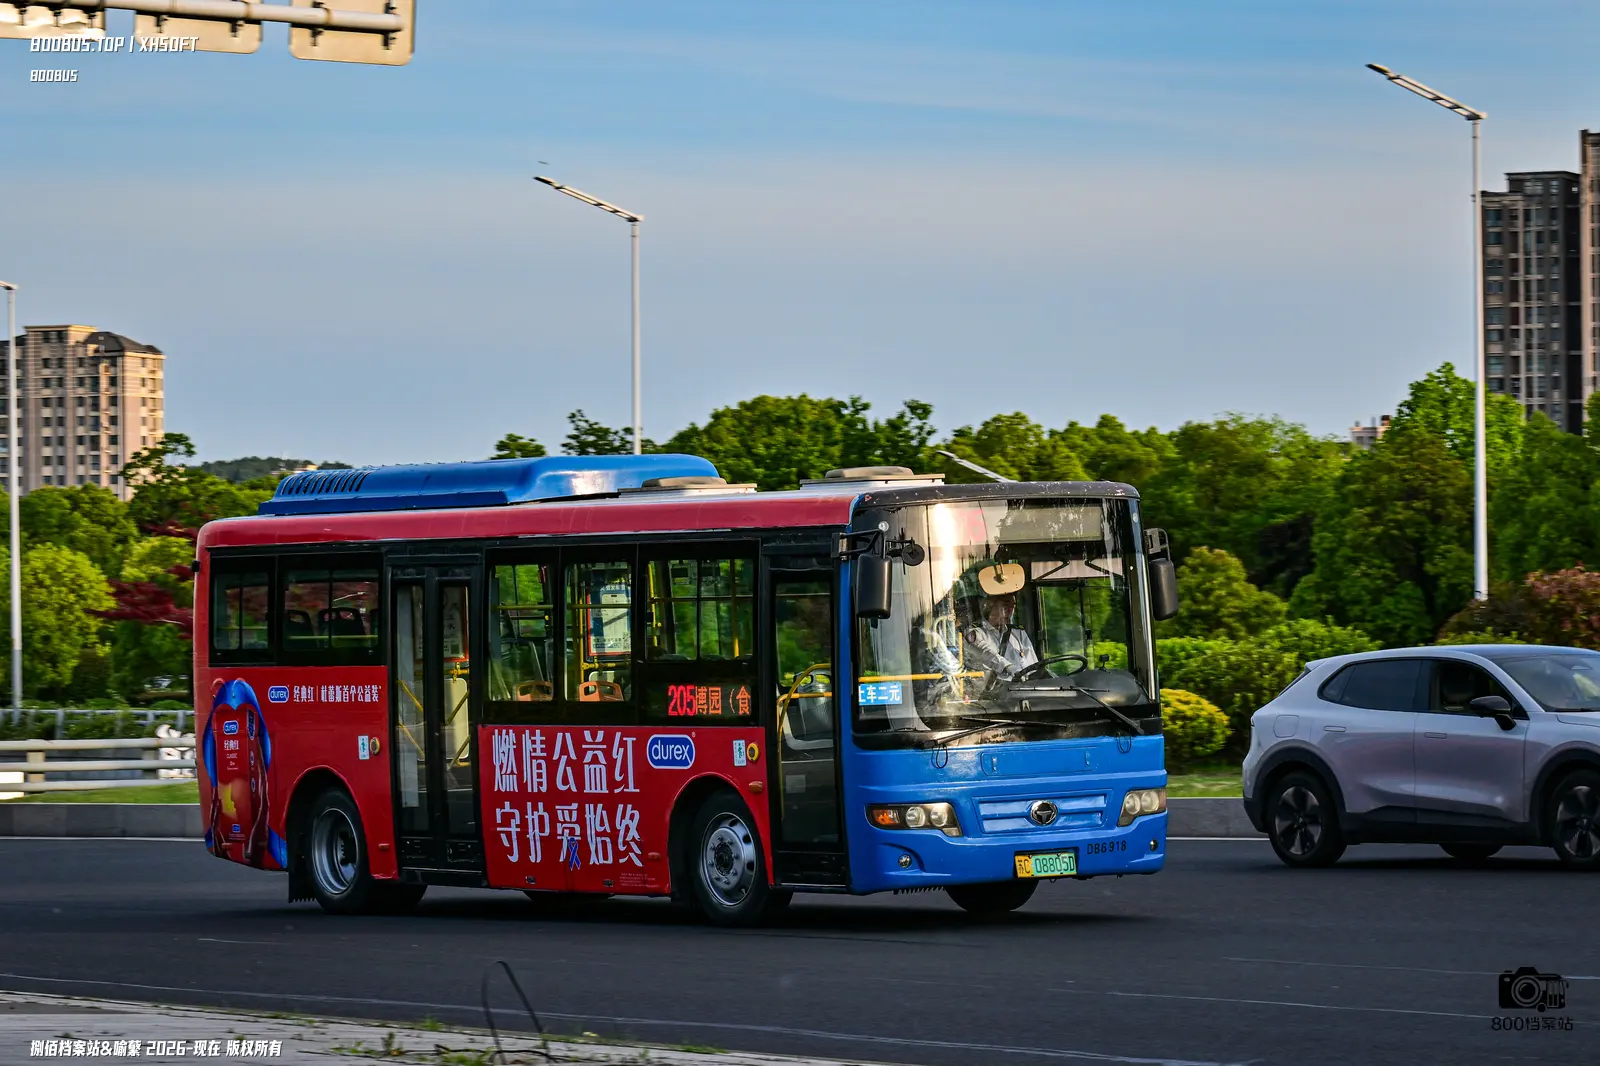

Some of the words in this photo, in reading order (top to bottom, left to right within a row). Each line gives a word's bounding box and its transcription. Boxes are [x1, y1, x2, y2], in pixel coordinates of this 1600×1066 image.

[667, 684, 696, 717] 205
[492, 729, 640, 793] 燃情公益红
[651, 739, 691, 764] durex
[495, 801, 644, 868] 守护爱始终
